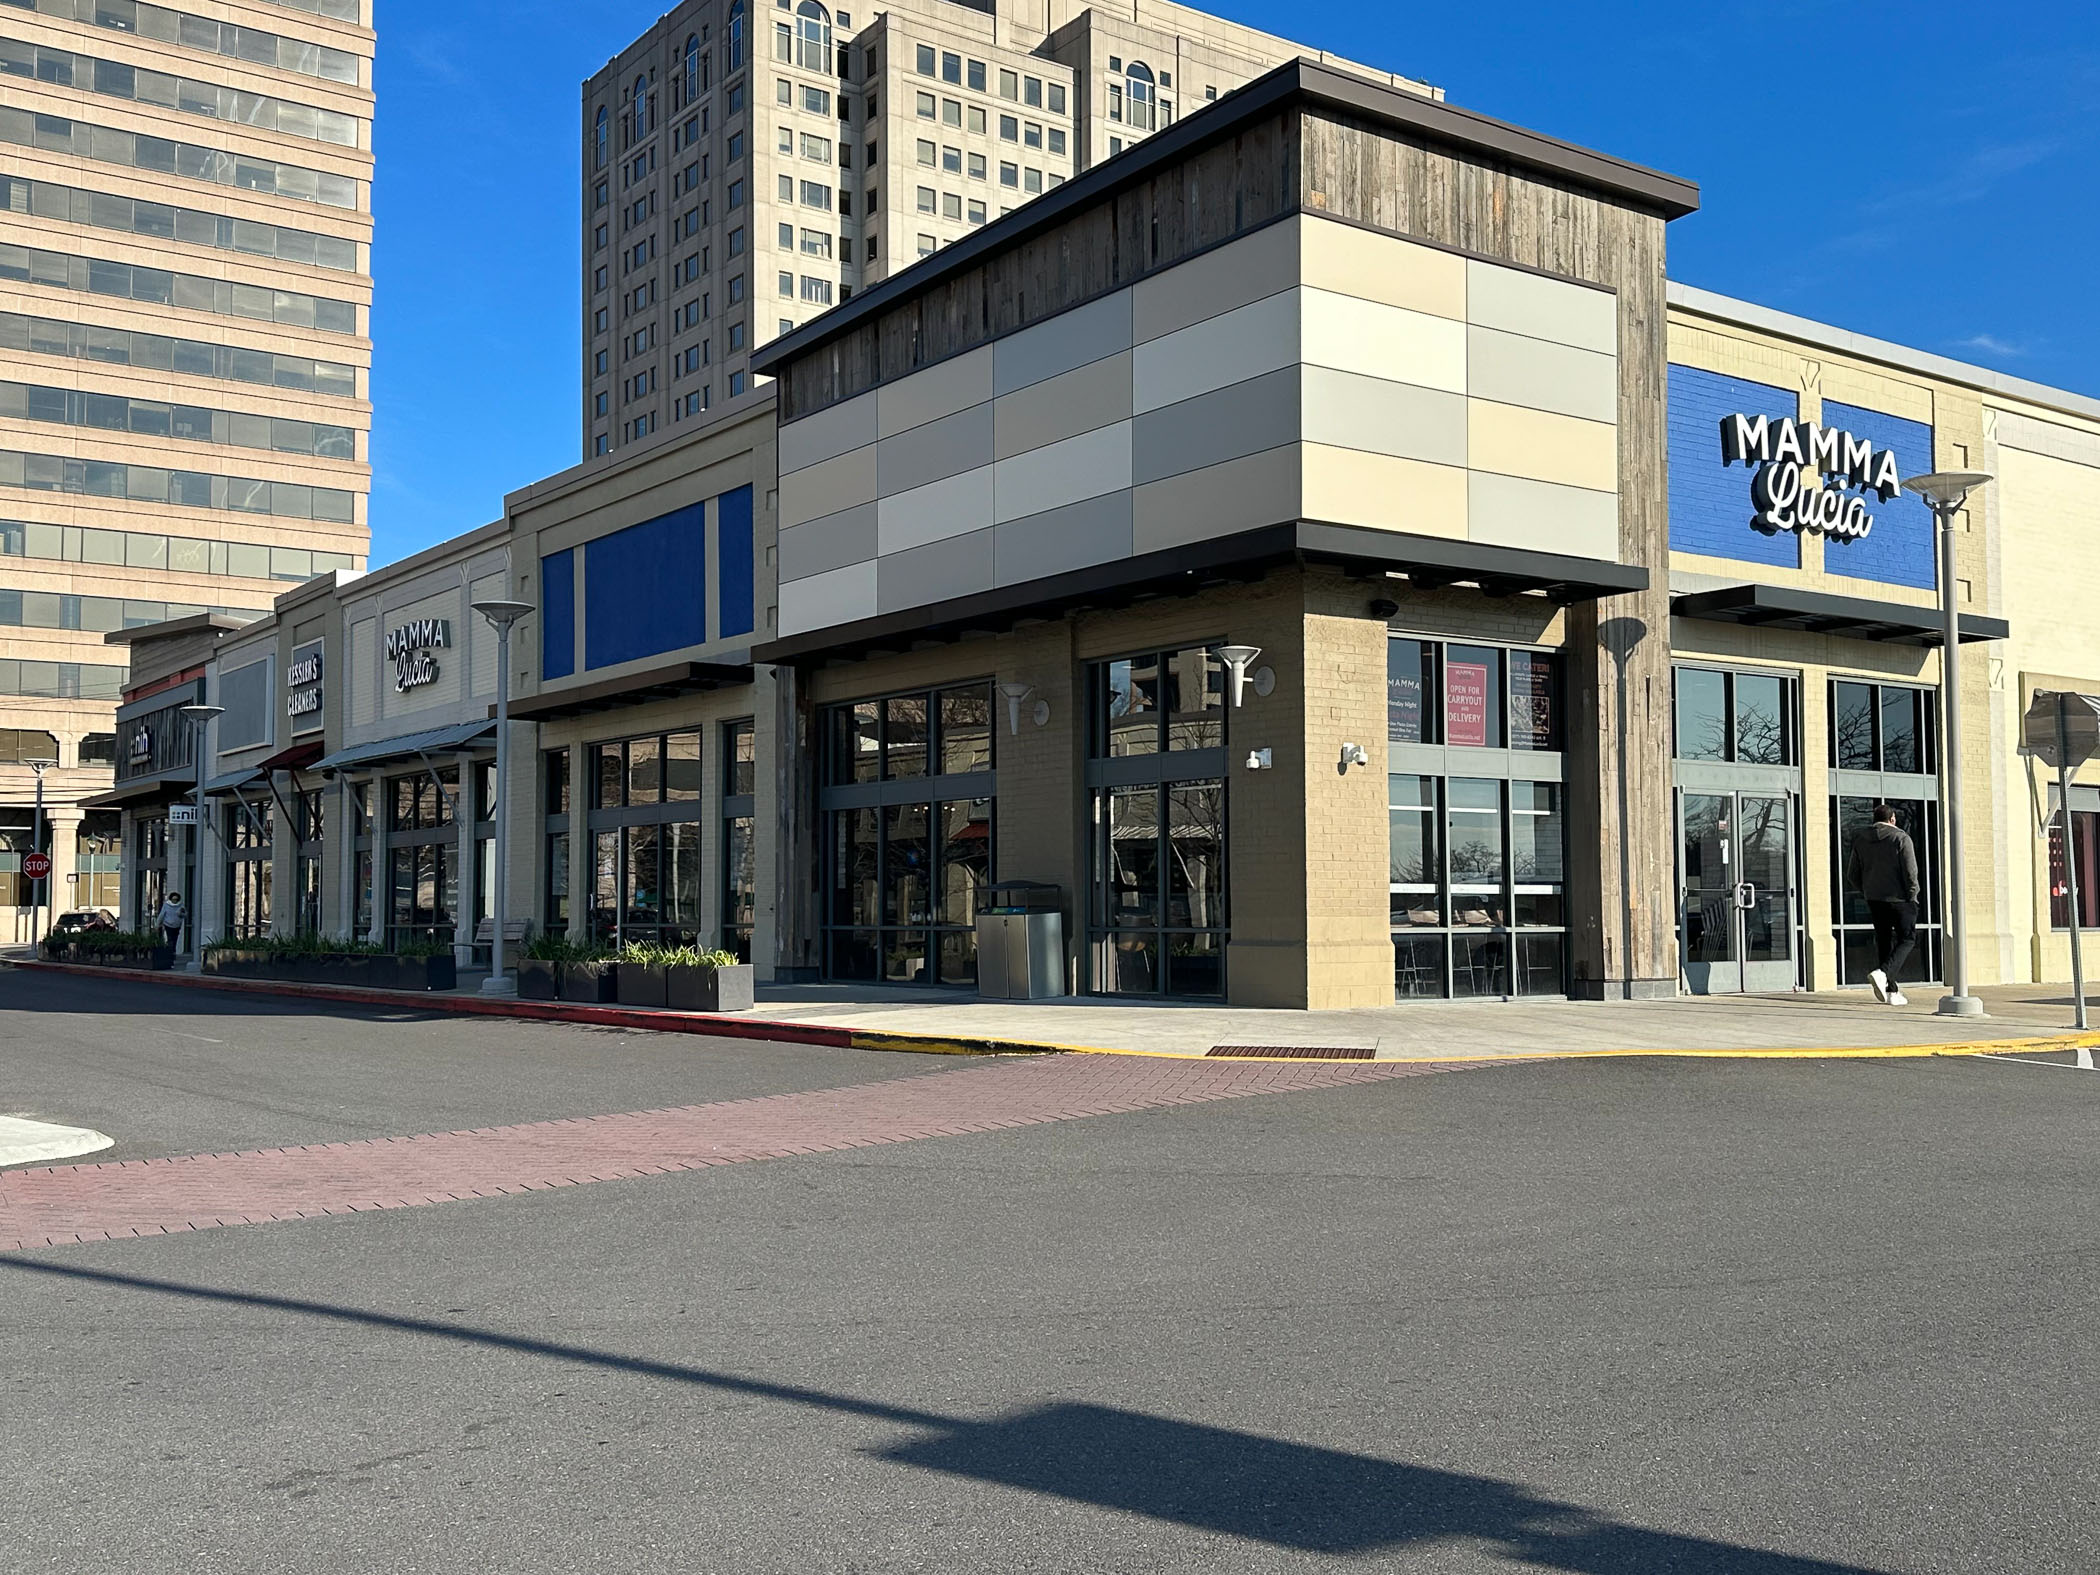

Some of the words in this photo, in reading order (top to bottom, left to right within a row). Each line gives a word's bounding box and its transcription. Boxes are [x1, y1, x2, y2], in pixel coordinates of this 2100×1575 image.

[1734, 413, 1901, 497] MAMMA
[1766, 461, 1874, 538] Lucia
[386, 618, 445, 660] MAMMA
[287, 654, 318, 687] KESSLER'S
[394, 651, 434, 692] Lucia
[287, 688, 318, 716] CLEANERS
[1447, 694, 1482, 706] CARRYOUT
[1450, 684, 1467, 694] OPEN
[1468, 686, 1480, 695] FOR
[1449, 712, 1481, 723] DELIVERY
[25, 861, 49, 871] STOP
